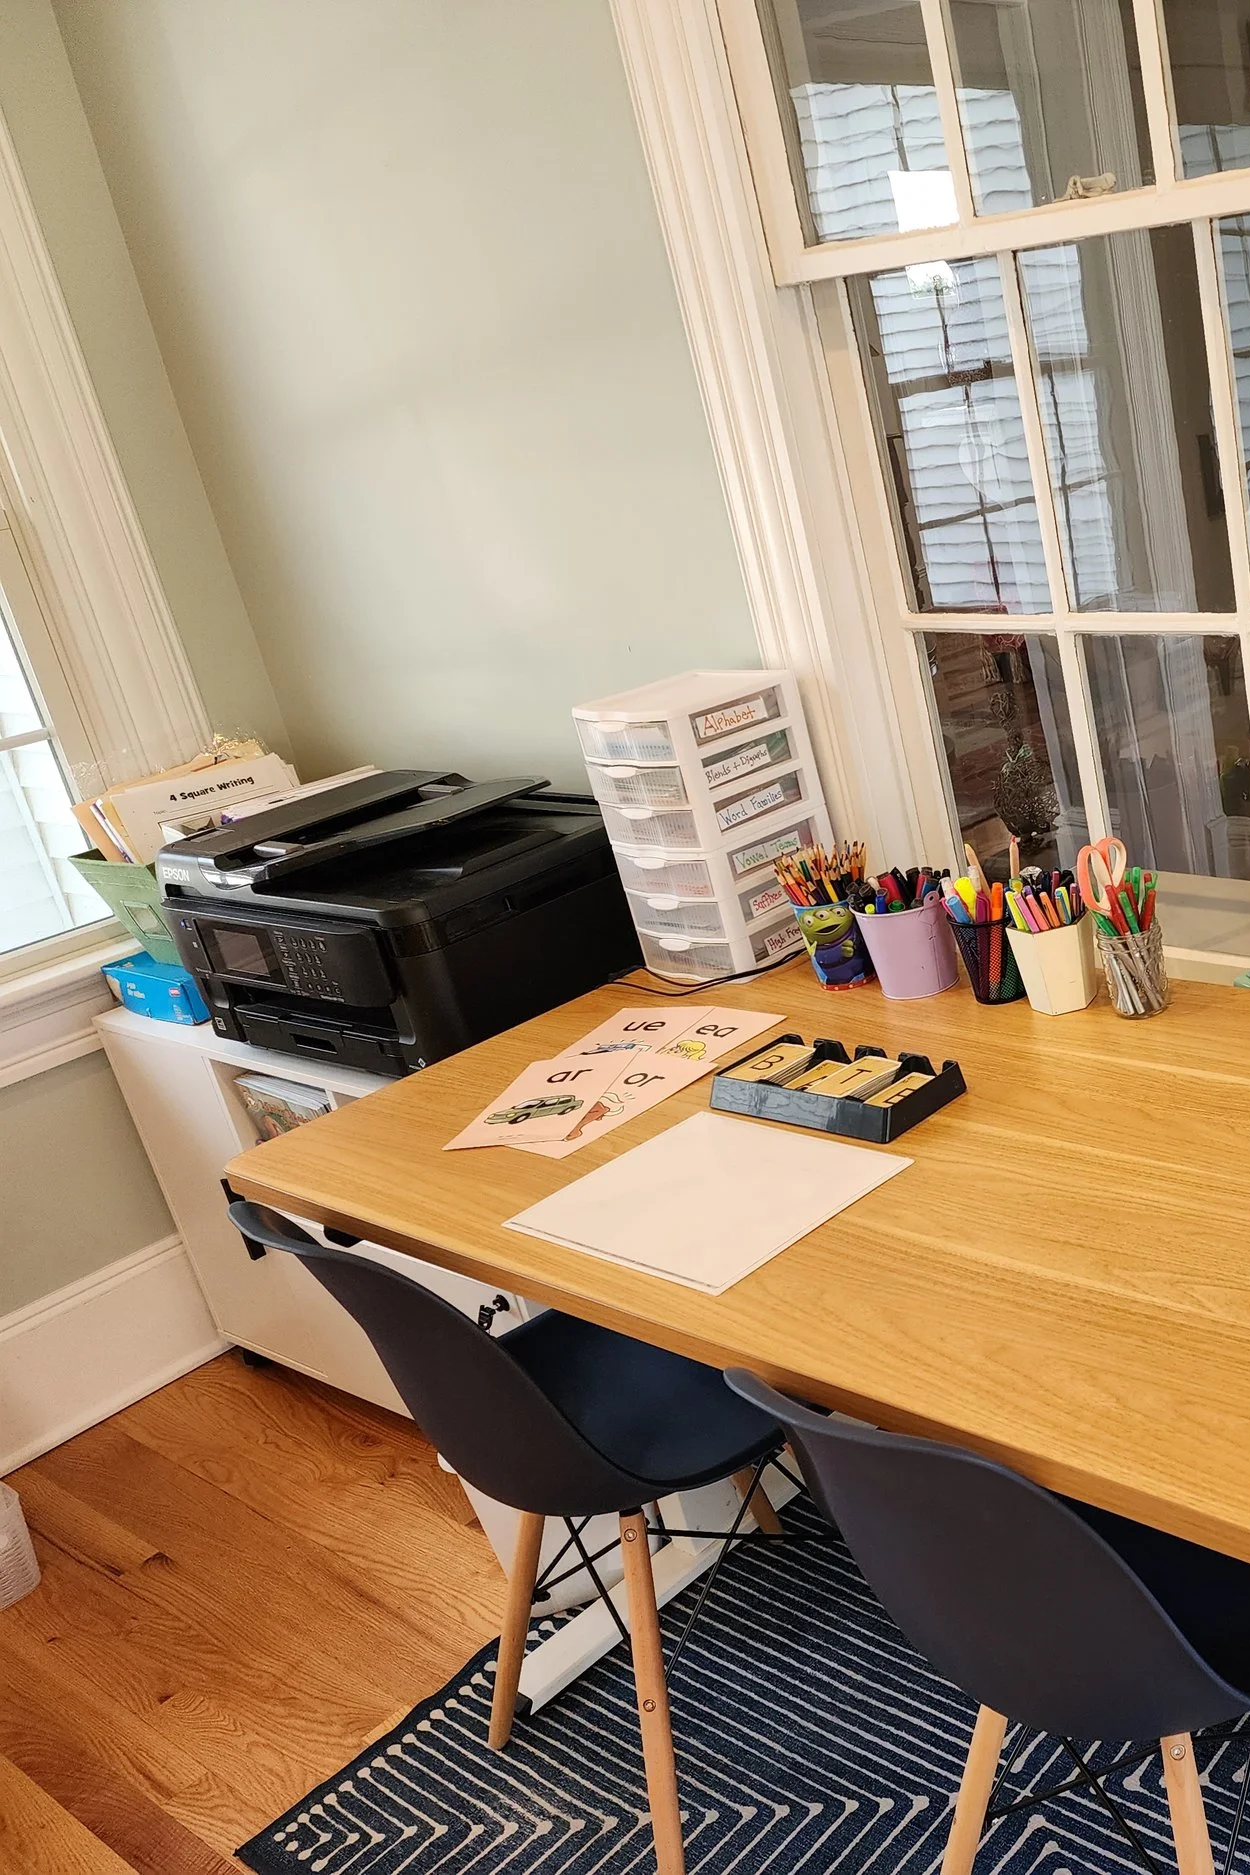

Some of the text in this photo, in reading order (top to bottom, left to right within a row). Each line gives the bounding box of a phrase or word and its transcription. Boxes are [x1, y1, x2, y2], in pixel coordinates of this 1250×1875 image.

[703, 708, 756, 735] Alphabet
[705, 764, 731, 784] Blends
[169, 775, 256, 802] 4 Square Writing
[719, 788, 783, 827] Word Families
[735, 844, 770, 869] Vowel
[163, 866, 190, 882] EPSON
[752, 889, 783, 911] Suffixes
[767, 933, 786, 952] High
[623, 1020, 667, 1032] ue
[695, 1024, 740, 1038] ea
[750, 1055, 785, 1071] B
[546, 1068, 594, 1084] ar
[623, 1072, 666, 1088] or
[840, 1068, 872, 1085] T
